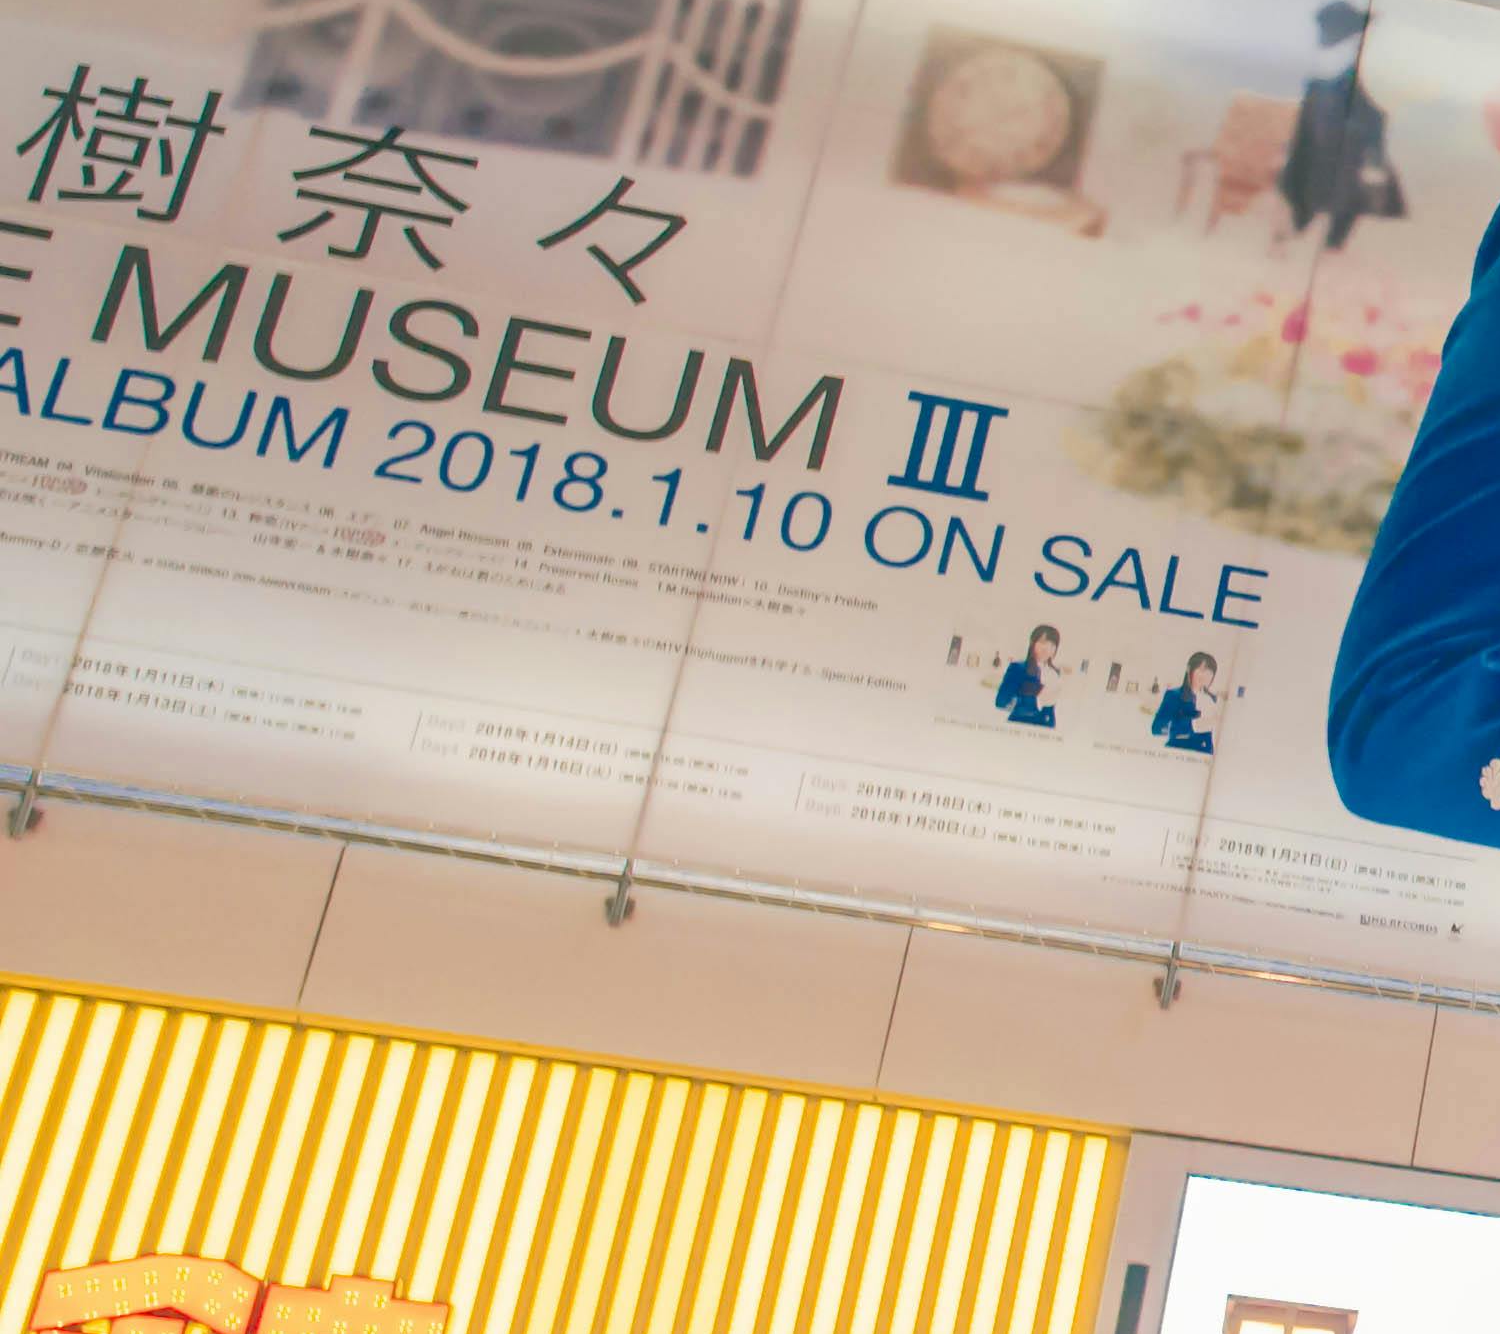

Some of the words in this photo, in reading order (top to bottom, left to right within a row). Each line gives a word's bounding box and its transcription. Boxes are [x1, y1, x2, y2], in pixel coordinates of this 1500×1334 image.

[0, 340, 353, 474] ALBUM
[373, 413, 834, 555] 2018.1.10
[864, 503, 1006, 584] ON
[1034, 533, 1270, 629] SALE
[91, 240, 845, 478] MUSEUM
